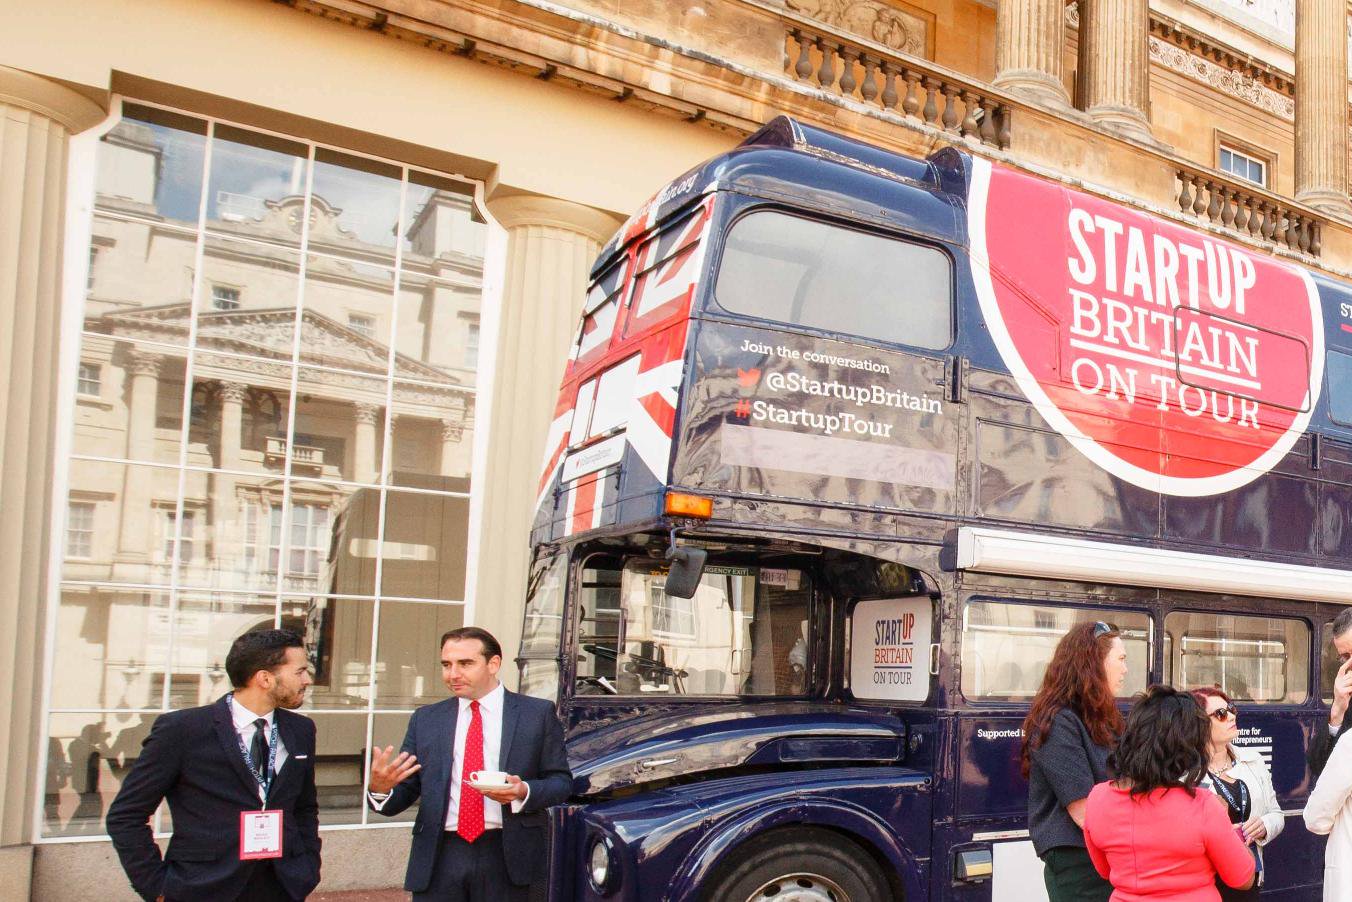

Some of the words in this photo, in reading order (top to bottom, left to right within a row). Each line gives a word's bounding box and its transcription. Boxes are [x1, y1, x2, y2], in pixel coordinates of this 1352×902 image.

[1068, 208, 1256, 315] STARTUP
[1069, 288, 1259, 377] BRITAIN
[741, 340, 773, 356] Join
[777, 346, 800, 359] the
[803, 352, 890, 374] conversation
[766, 372, 943, 414] @StartupBritain
[1071, 358, 1138, 403] ON
[1151, 375, 1261, 429] TOUR
[704, 565, 731, 575] RGENCY
[874, 648, 913, 663] BRITAIN
[873, 671, 886, 684] ON
[888, 671, 912, 685] TOUR
[977, 728, 1020, 739] Supported
[1251, 727, 1261, 735] for
[1232, 736, 1273, 745] ntrepreneurs
